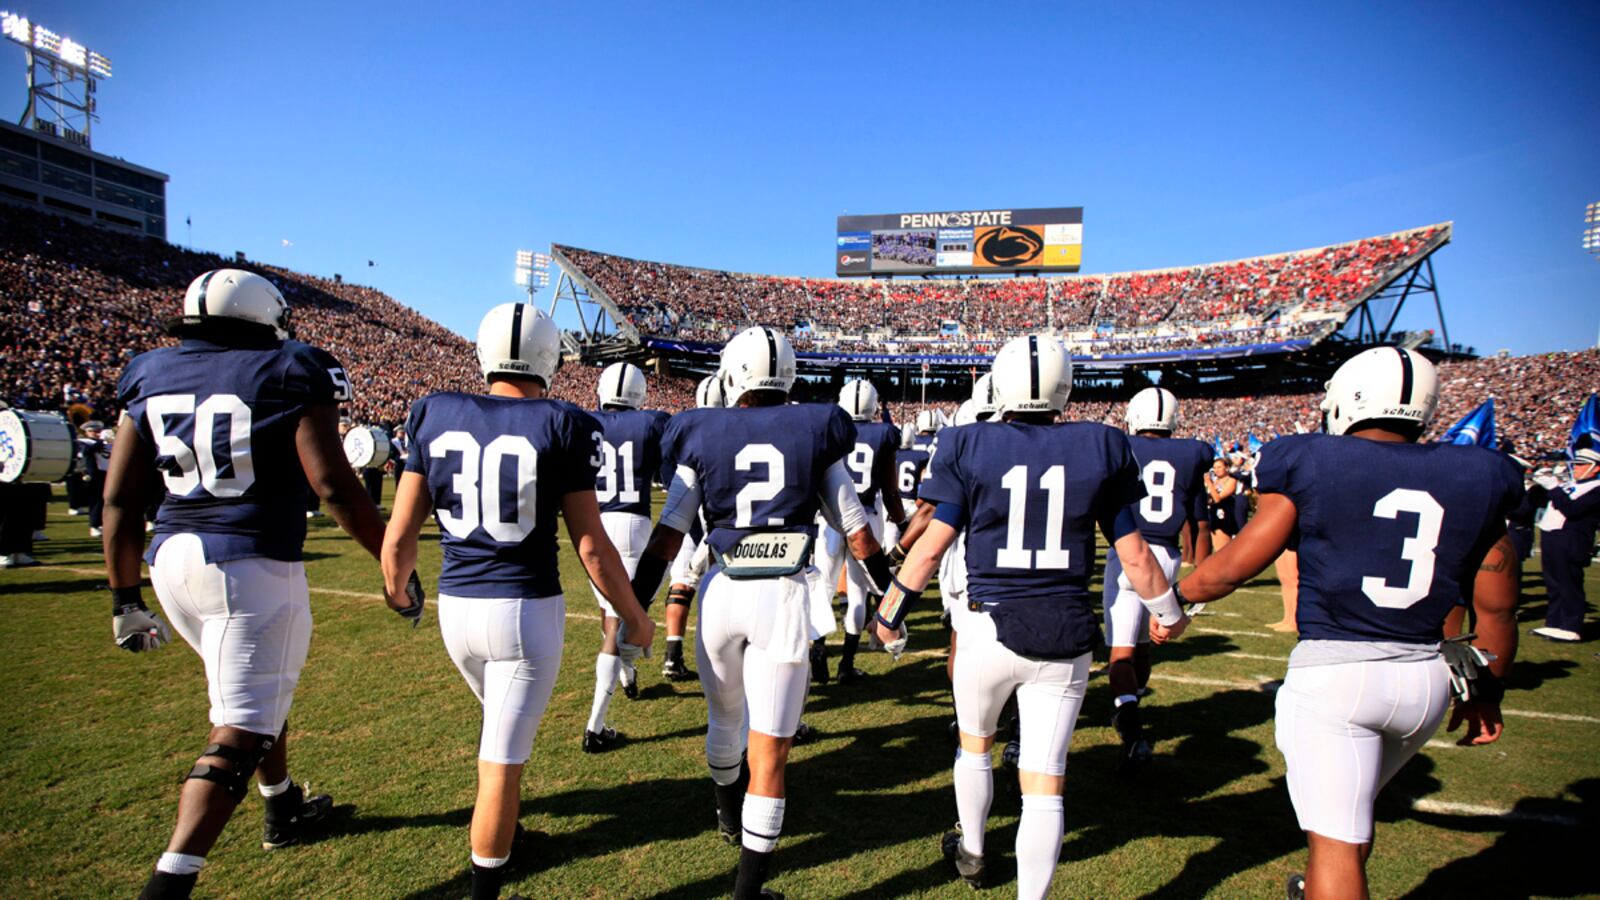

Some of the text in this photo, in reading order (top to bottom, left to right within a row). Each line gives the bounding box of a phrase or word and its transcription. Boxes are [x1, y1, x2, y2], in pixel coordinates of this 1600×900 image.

[900, 211, 1012, 228] PENN STATE
[146, 394, 254, 497] 50
[847, 442, 874, 494] 9
[898, 460, 916, 493] 6
[428, 430, 538, 543] 30
[735, 443, 785, 527] 2
[996, 465, 1070, 569] 11
[1139, 459, 1176, 524] 8
[735, 543, 788, 559] DOUGLAS
[1361, 487, 1445, 610] 3
